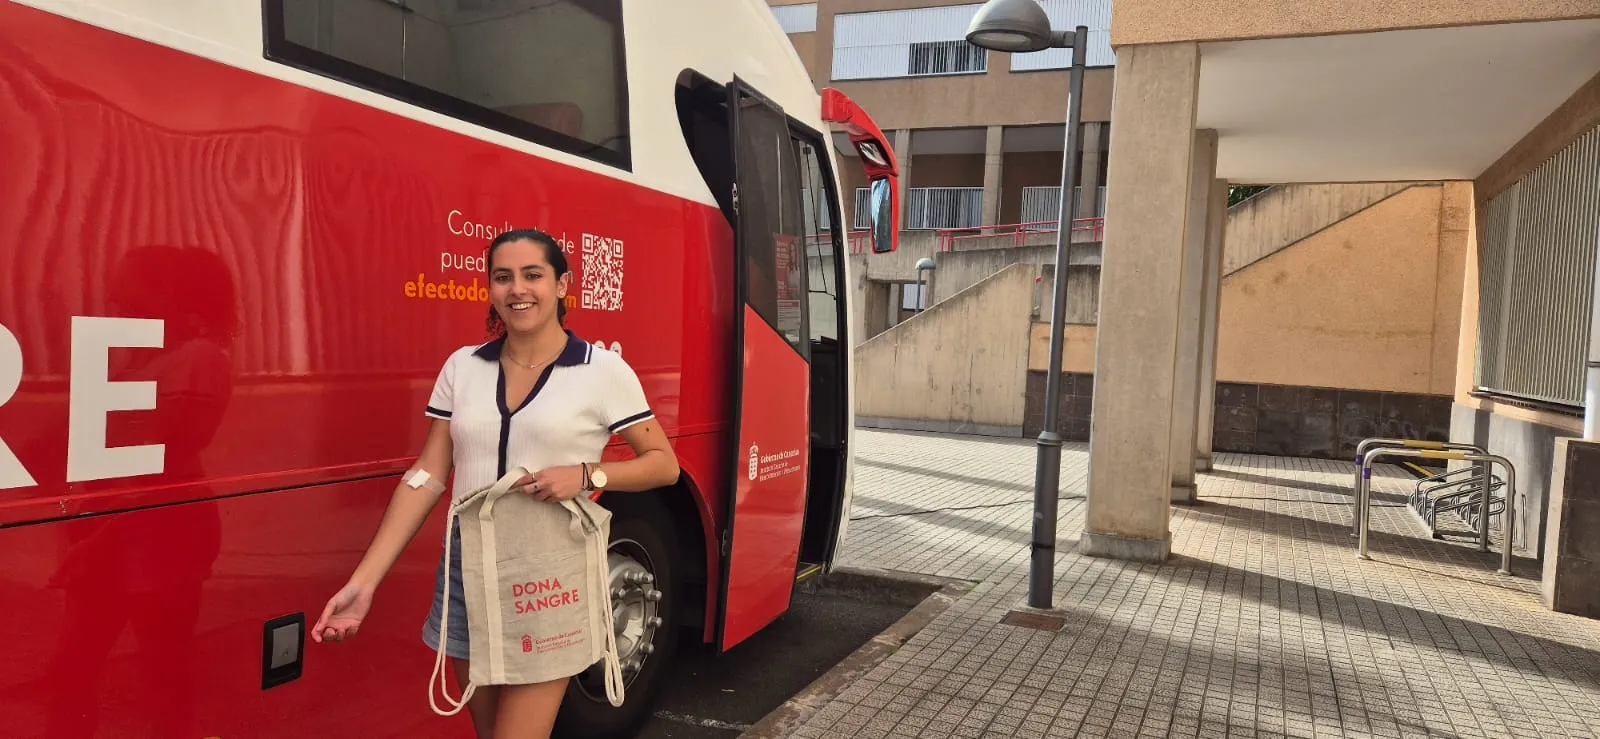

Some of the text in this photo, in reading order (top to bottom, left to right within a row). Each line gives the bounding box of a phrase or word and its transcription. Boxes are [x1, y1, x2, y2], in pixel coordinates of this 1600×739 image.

[441, 250, 486, 273] pued
[513, 578, 562, 597] DONA
[515, 589, 579, 614] SANGRE
